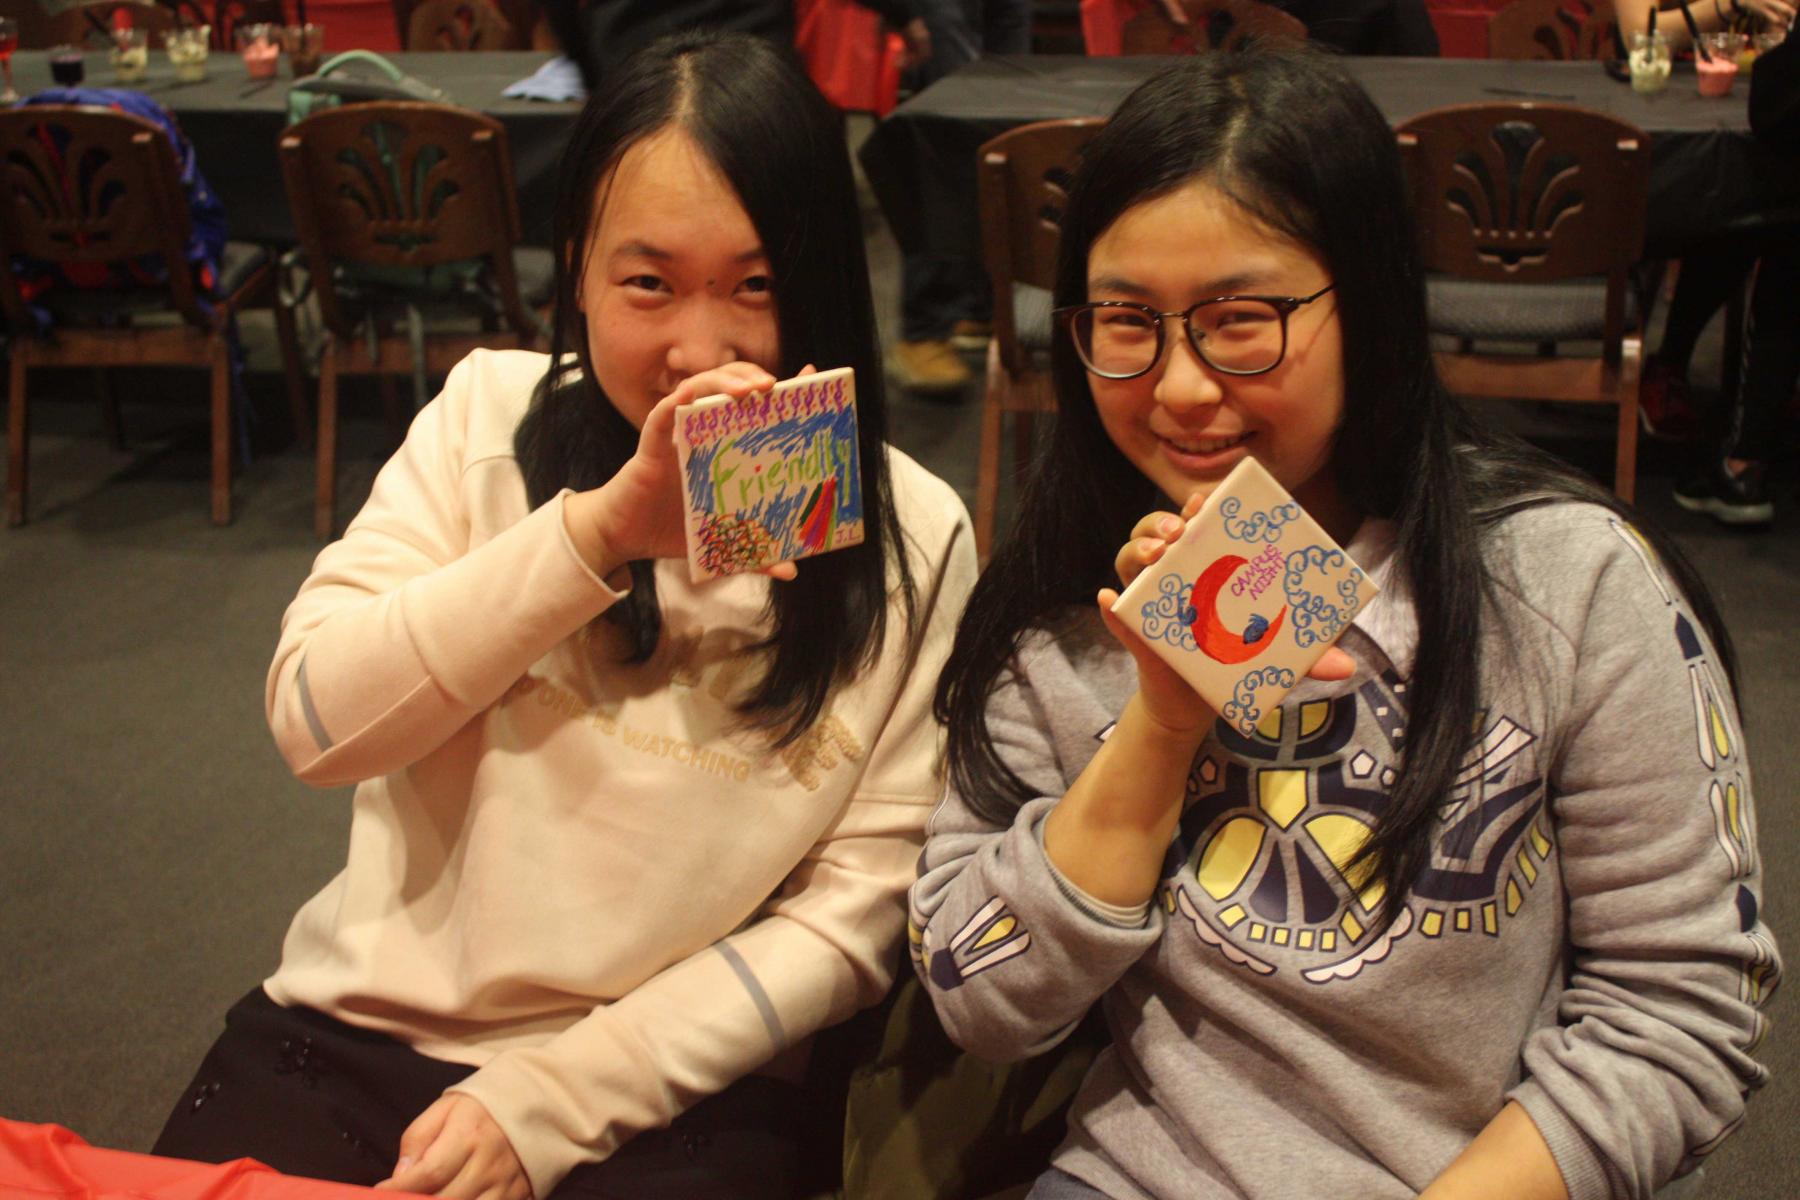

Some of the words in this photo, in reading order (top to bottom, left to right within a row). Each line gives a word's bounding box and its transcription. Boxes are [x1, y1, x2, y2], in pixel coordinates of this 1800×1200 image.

[713, 427, 850, 516] Friendly
[1231, 544, 1281, 597] CAMPUS
[1249, 551, 1287, 600] NIGHT
[592, 709, 617, 736] IS
[623, 726, 750, 784] WATCHING
